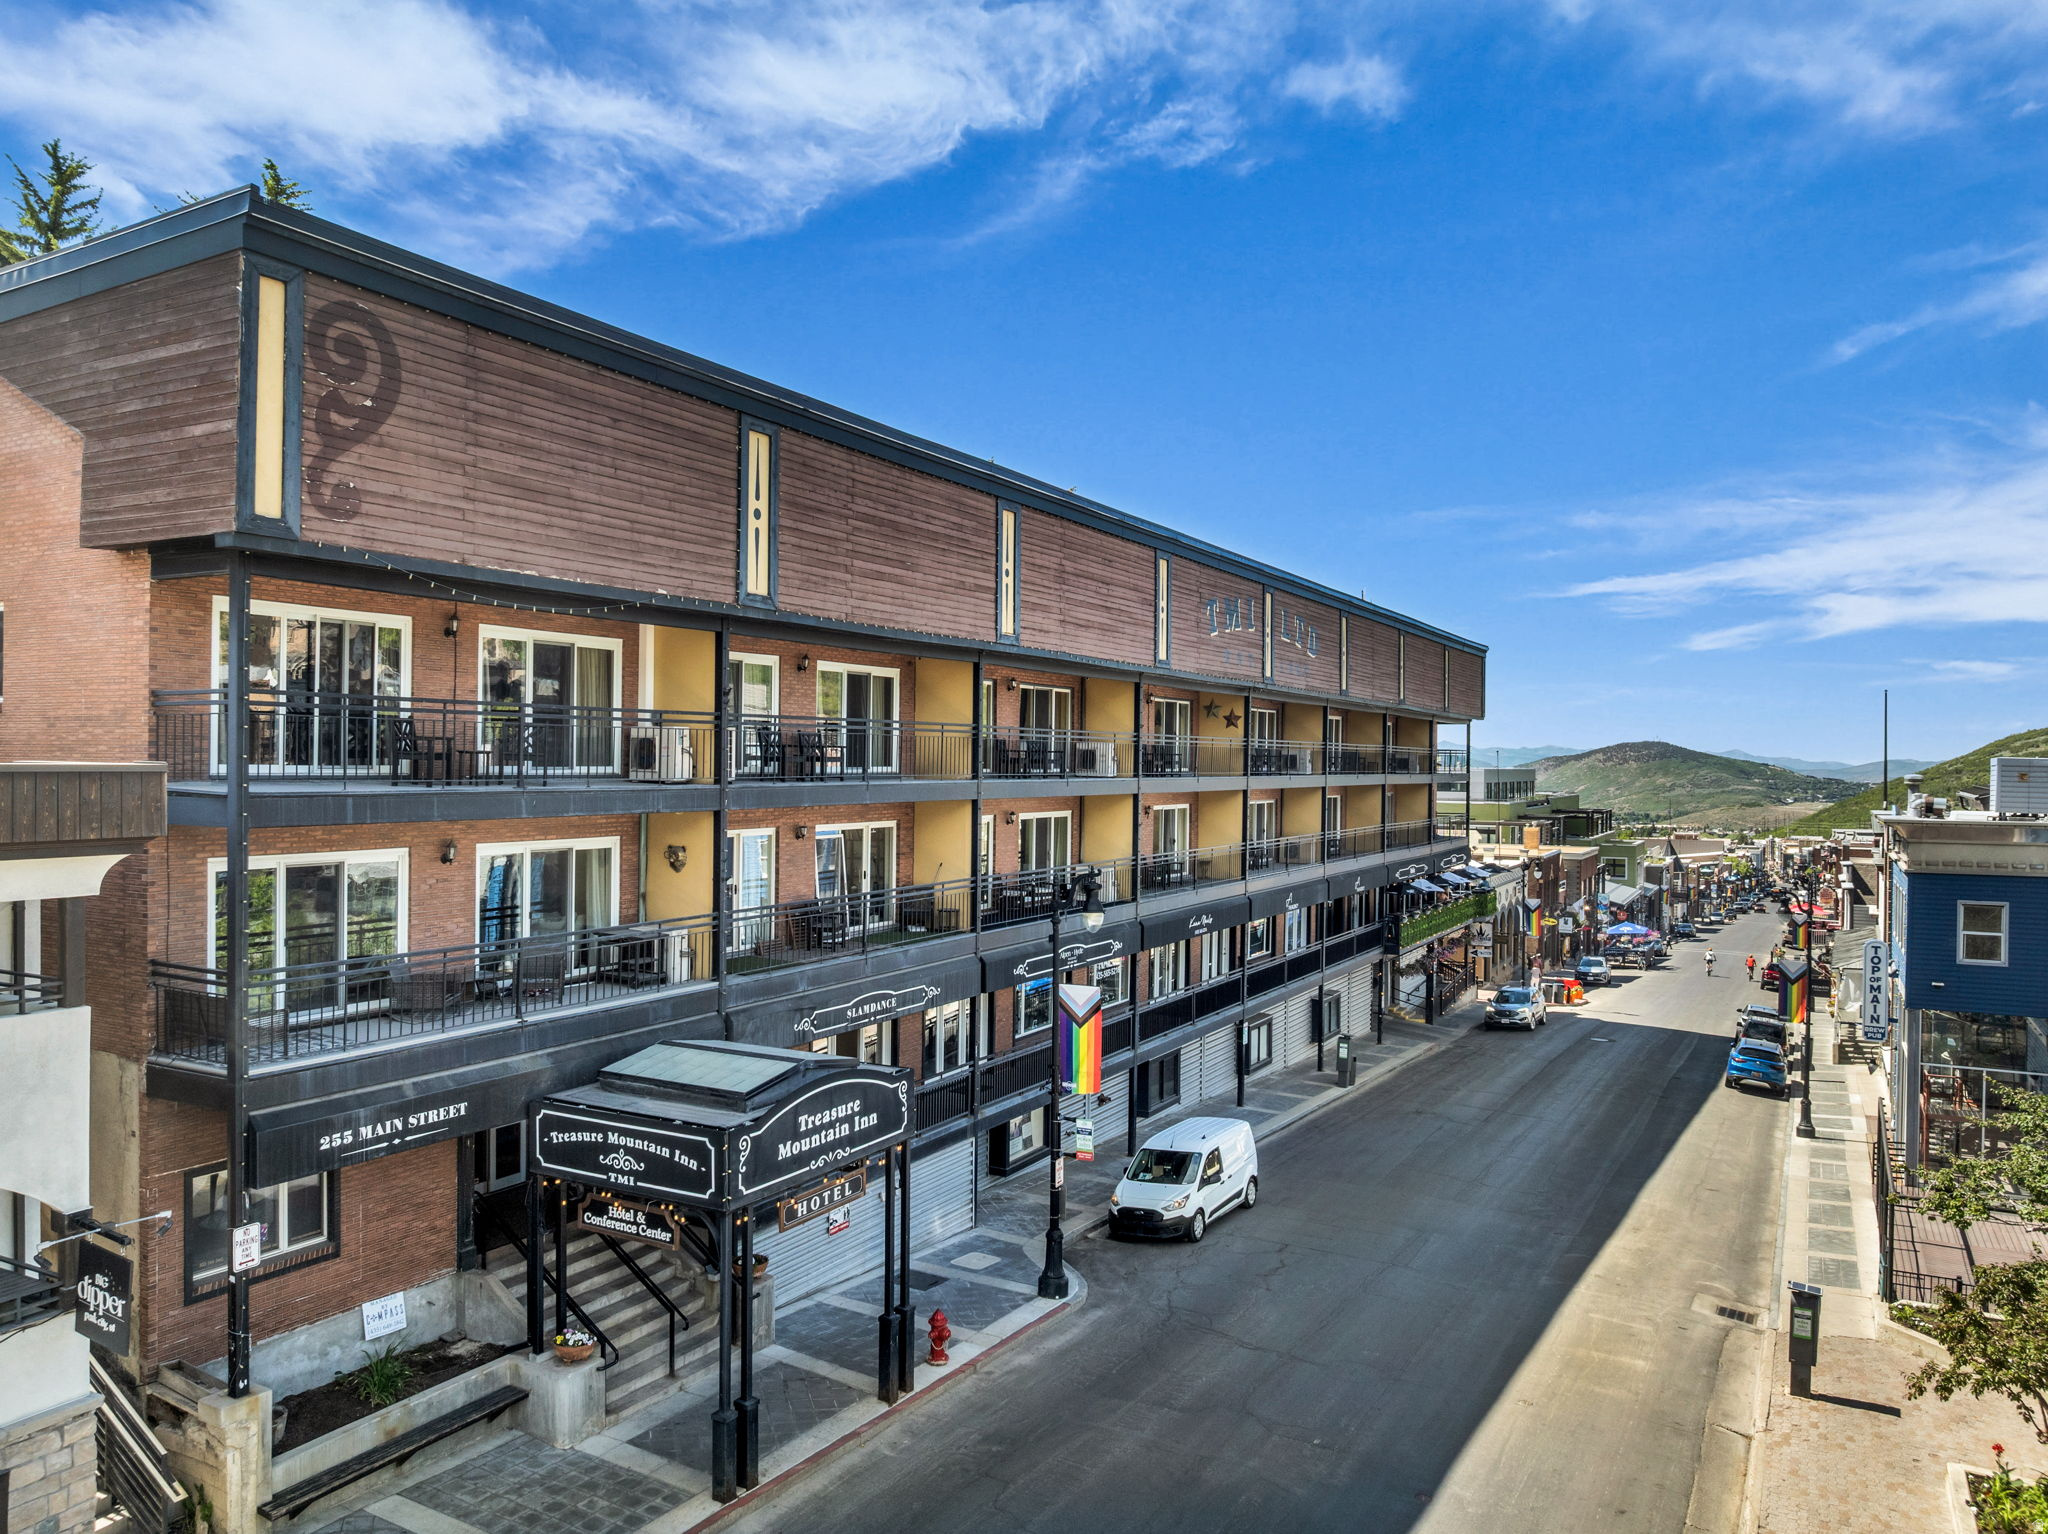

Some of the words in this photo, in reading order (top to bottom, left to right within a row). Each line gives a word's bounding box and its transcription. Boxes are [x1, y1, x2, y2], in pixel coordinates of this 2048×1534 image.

[1206, 597, 1256, 637] TMI
[1870, 945, 1882, 975] TOP
[846, 997, 897, 1019] SLAMDANCE
[1869, 984, 1882, 1024] MAIN
[319, 1129, 354, 1151] 255
[358, 1117, 404, 1142] MAIN
[407, 1101, 468, 1129] STREET
[798, 1099, 861, 1132] Treasure
[550, 1131, 604, 1144] Treasure
[607, 1131, 670, 1159] Mountain
[674, 1149, 698, 1171] Inn
[777, 1122, 850, 1161] Mountain
[853, 1112, 878, 1132] Inn
[608, 1172, 635, 1186] TMI
[608, 1205, 635, 1225] Hotel
[636, 1211, 646, 1224] &
[797, 1181, 853, 1218] HOTEL
[235, 1234, 258, 1247] PARKING
[583, 1212, 638, 1234] Conference
[638, 1224, 672, 1242] Center
[241, 1252, 252, 1260] TIME
[77, 1275, 126, 1317] dipper
[95, 1273, 109, 1289] BIG
